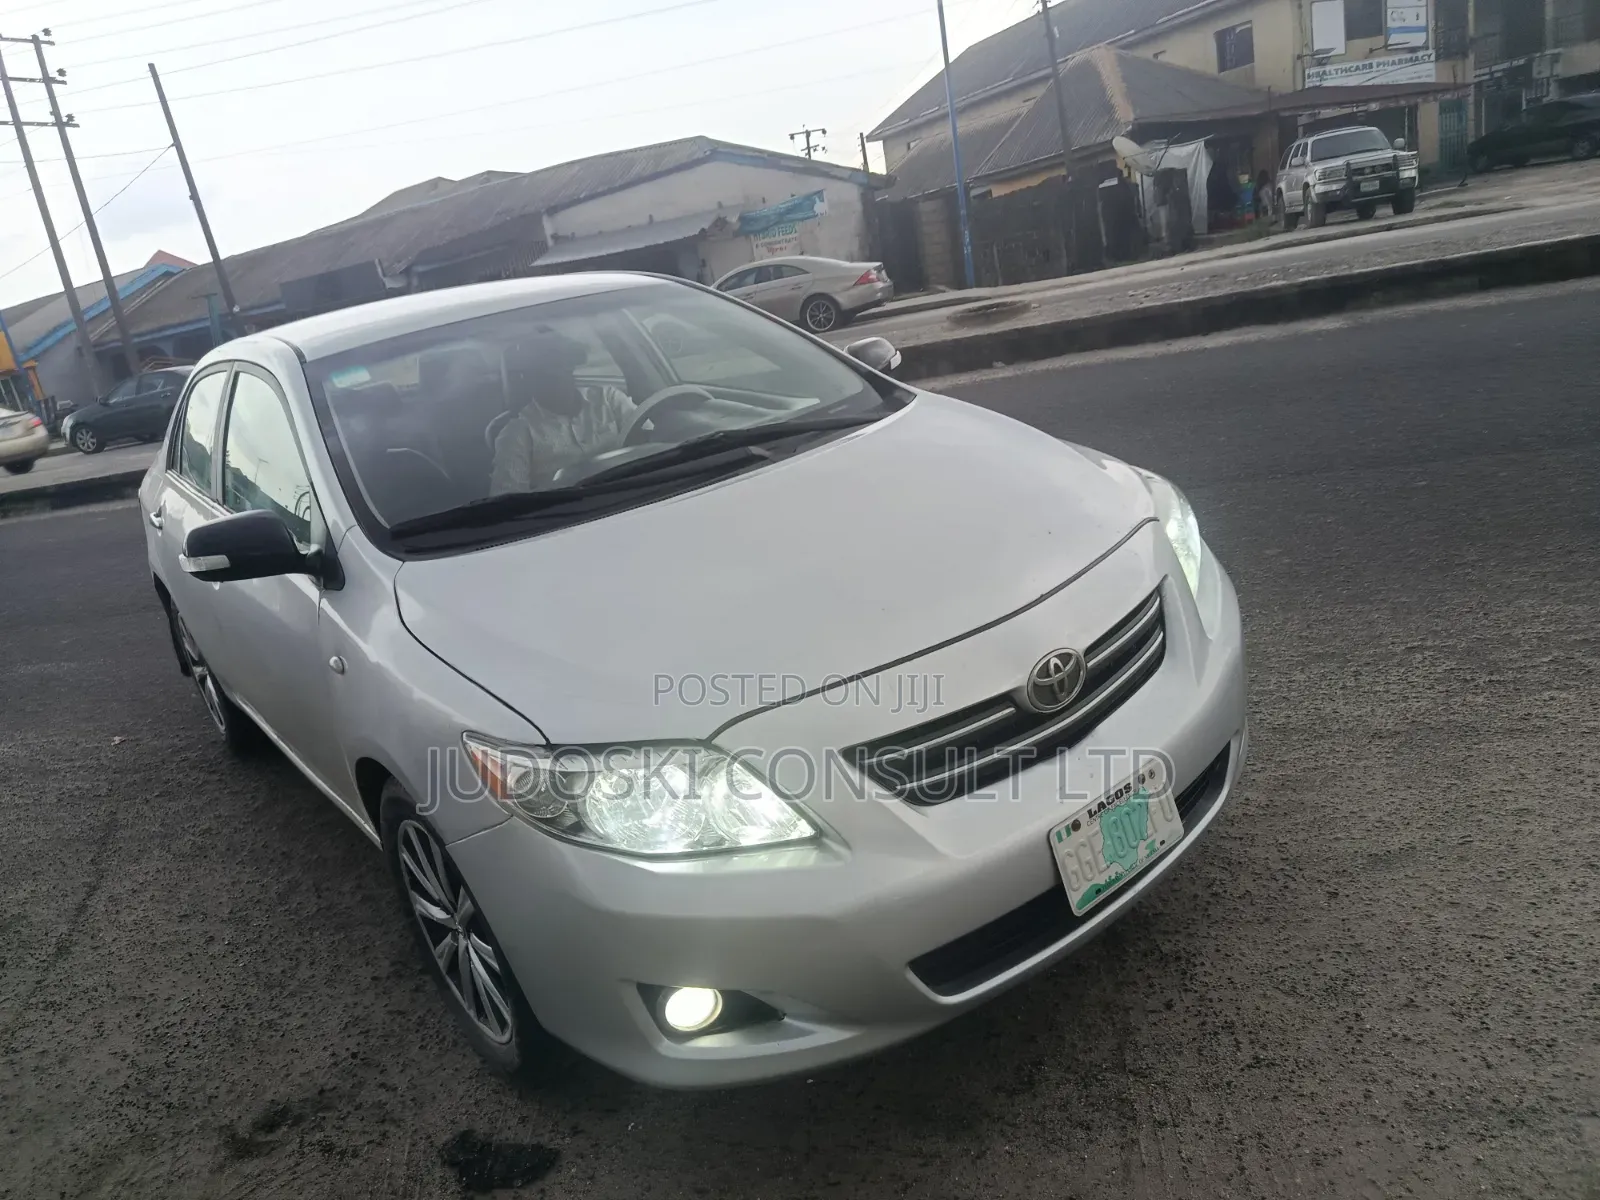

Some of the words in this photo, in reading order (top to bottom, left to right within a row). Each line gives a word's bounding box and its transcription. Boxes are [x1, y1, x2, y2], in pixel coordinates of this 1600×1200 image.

[1307, 61, 1374, 80] HEALTHCARE
[1376, 53, 1433, 69] PHARMACY
[1087, 782, 1132, 819] LAGOS
